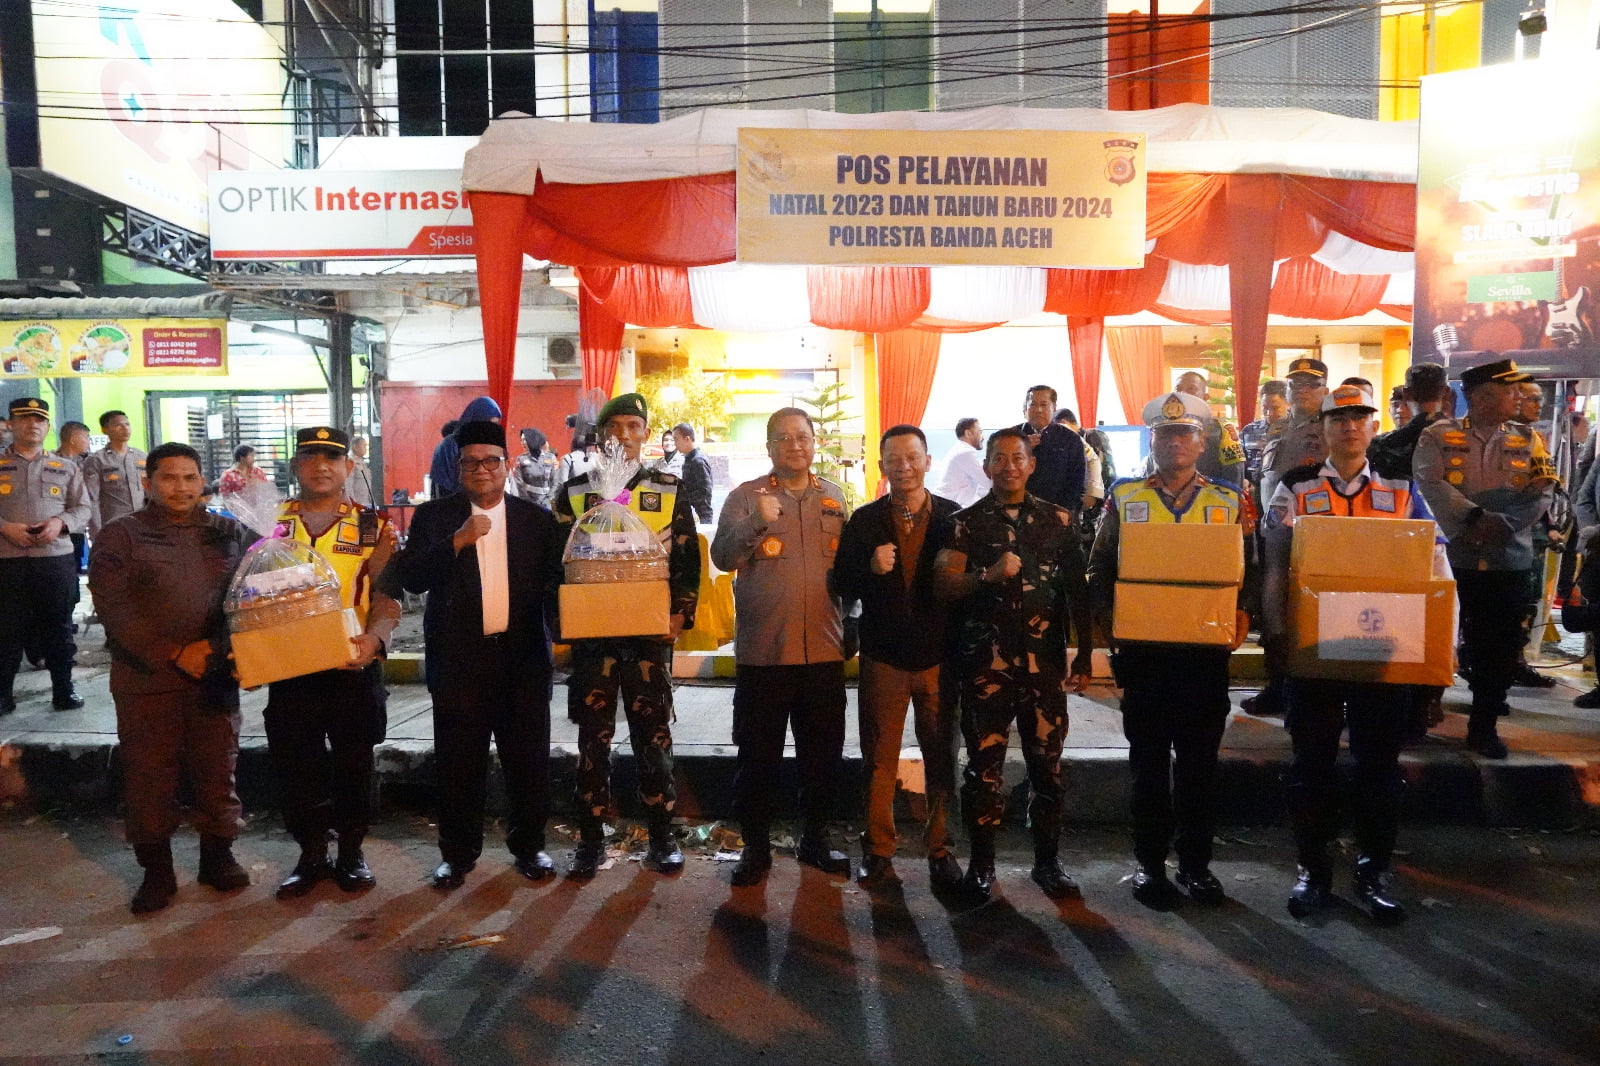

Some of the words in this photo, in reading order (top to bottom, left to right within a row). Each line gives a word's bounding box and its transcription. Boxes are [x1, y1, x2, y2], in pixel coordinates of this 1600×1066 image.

[836, 155, 890, 185] POS
[898, 156, 1047, 187] PELAYANAN
[218, 187, 308, 213] OPTIK
[769, 194, 828, 216] NATAL
[832, 194, 884, 217] 2023
[890, 195, 930, 217] DAN
[934, 195, 998, 218] TAHUN
[1004, 196, 1056, 219] BARU
[1062, 197, 1113, 219] 2024
[428, 232, 473, 249] Spesia
[828, 225, 926, 248] POLRESTA
[930, 226, 997, 249] BANDA
[1002, 226, 1053, 249] ACEH
[1487, 285, 1532, 297] Sevilla
